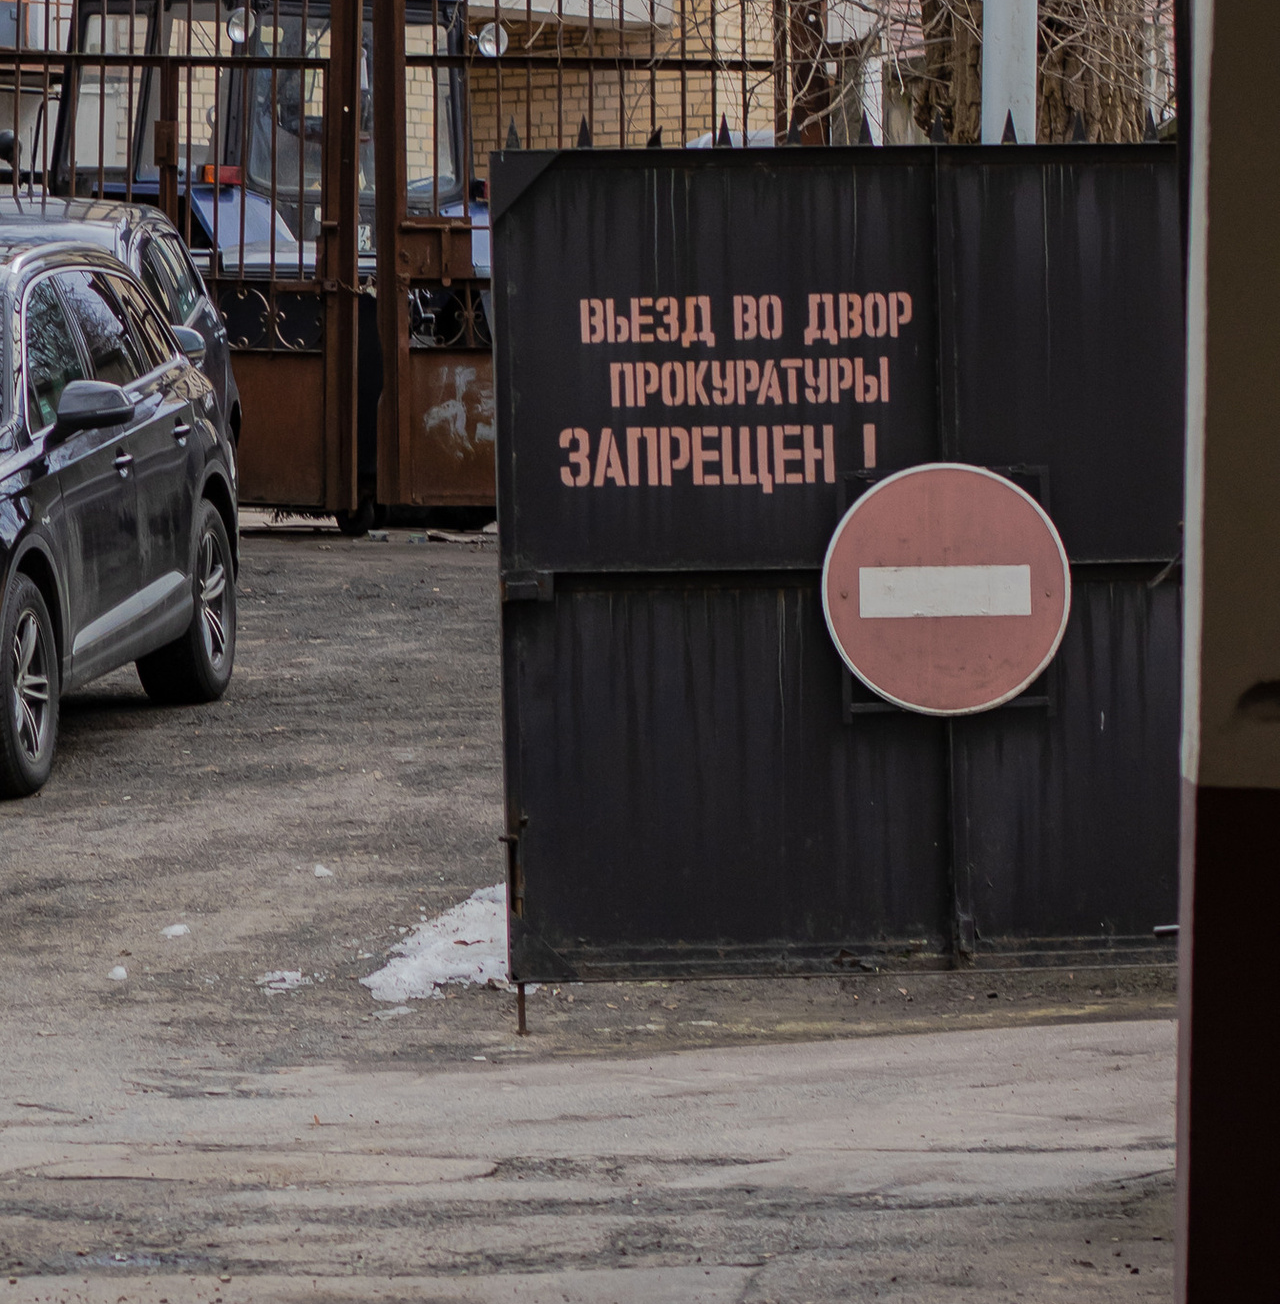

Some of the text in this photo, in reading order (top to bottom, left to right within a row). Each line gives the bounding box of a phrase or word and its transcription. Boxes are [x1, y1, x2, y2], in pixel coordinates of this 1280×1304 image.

[733, 295, 783, 340] ВО
[803, 291, 913, 345] ДВОР
[609, 356, 890, 407] ПРОКУРАТУРЫ
[558, 424, 836, 494] ЗАПРЕЩЕН
